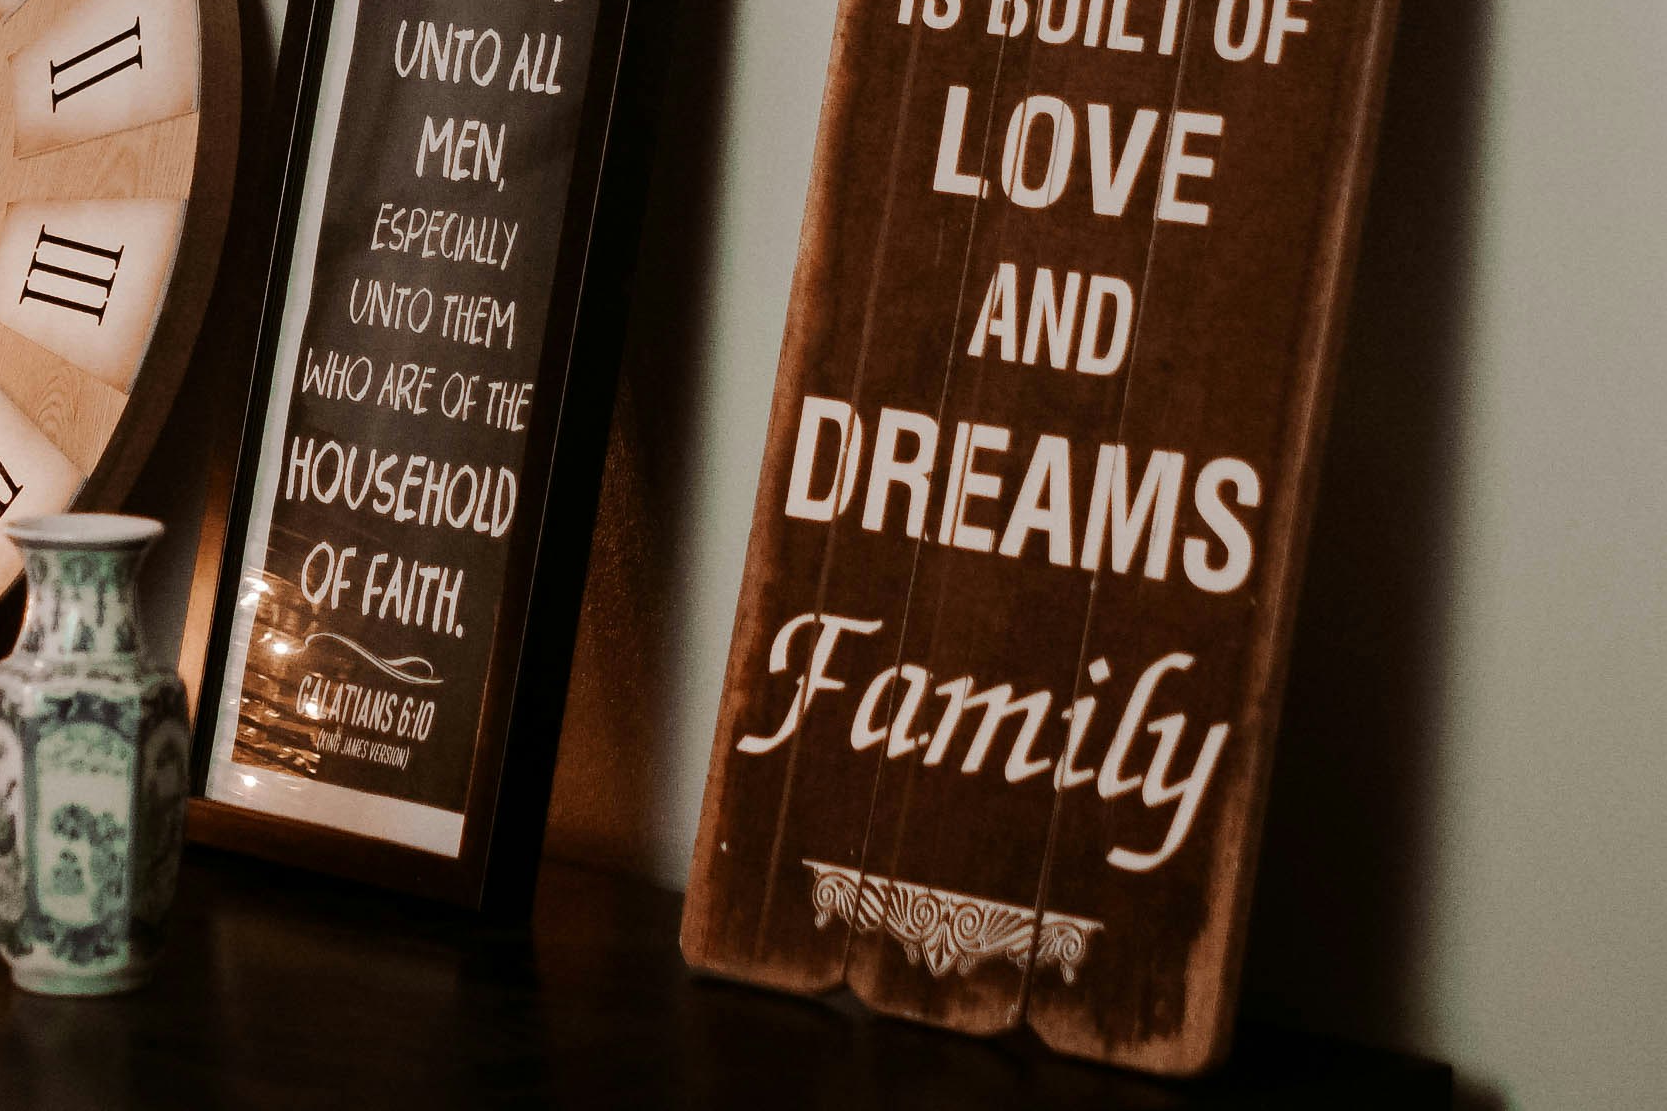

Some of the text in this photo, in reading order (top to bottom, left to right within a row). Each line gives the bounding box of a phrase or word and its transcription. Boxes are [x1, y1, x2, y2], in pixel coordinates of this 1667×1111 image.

[49, 16, 143, 114] II
[394, 20, 562, 95] UNTO ALL
[415, 116, 505, 191] MEN,
[932, 85, 1224, 226] LOVE
[19, 224, 125, 326] III
[370, 202, 518, 271] ESPECIALLY
[349, 278, 516, 349] UNTO THEM
[967, 262, 1134, 376] AND
[301, 347, 533, 432] WHO ARE OF THE
[285, 436, 517, 538] HOUSEHOLD
[784, 395, 1262, 594] DREAMS
[301, 541, 465, 639] OF FAITH.
[296, 675, 435, 741] GALATIANS 6:10
[341, 737, 369, 760] JAMES
[369, 742, 410, 771] VERSION)
[736, 613, 1230, 872] Family
